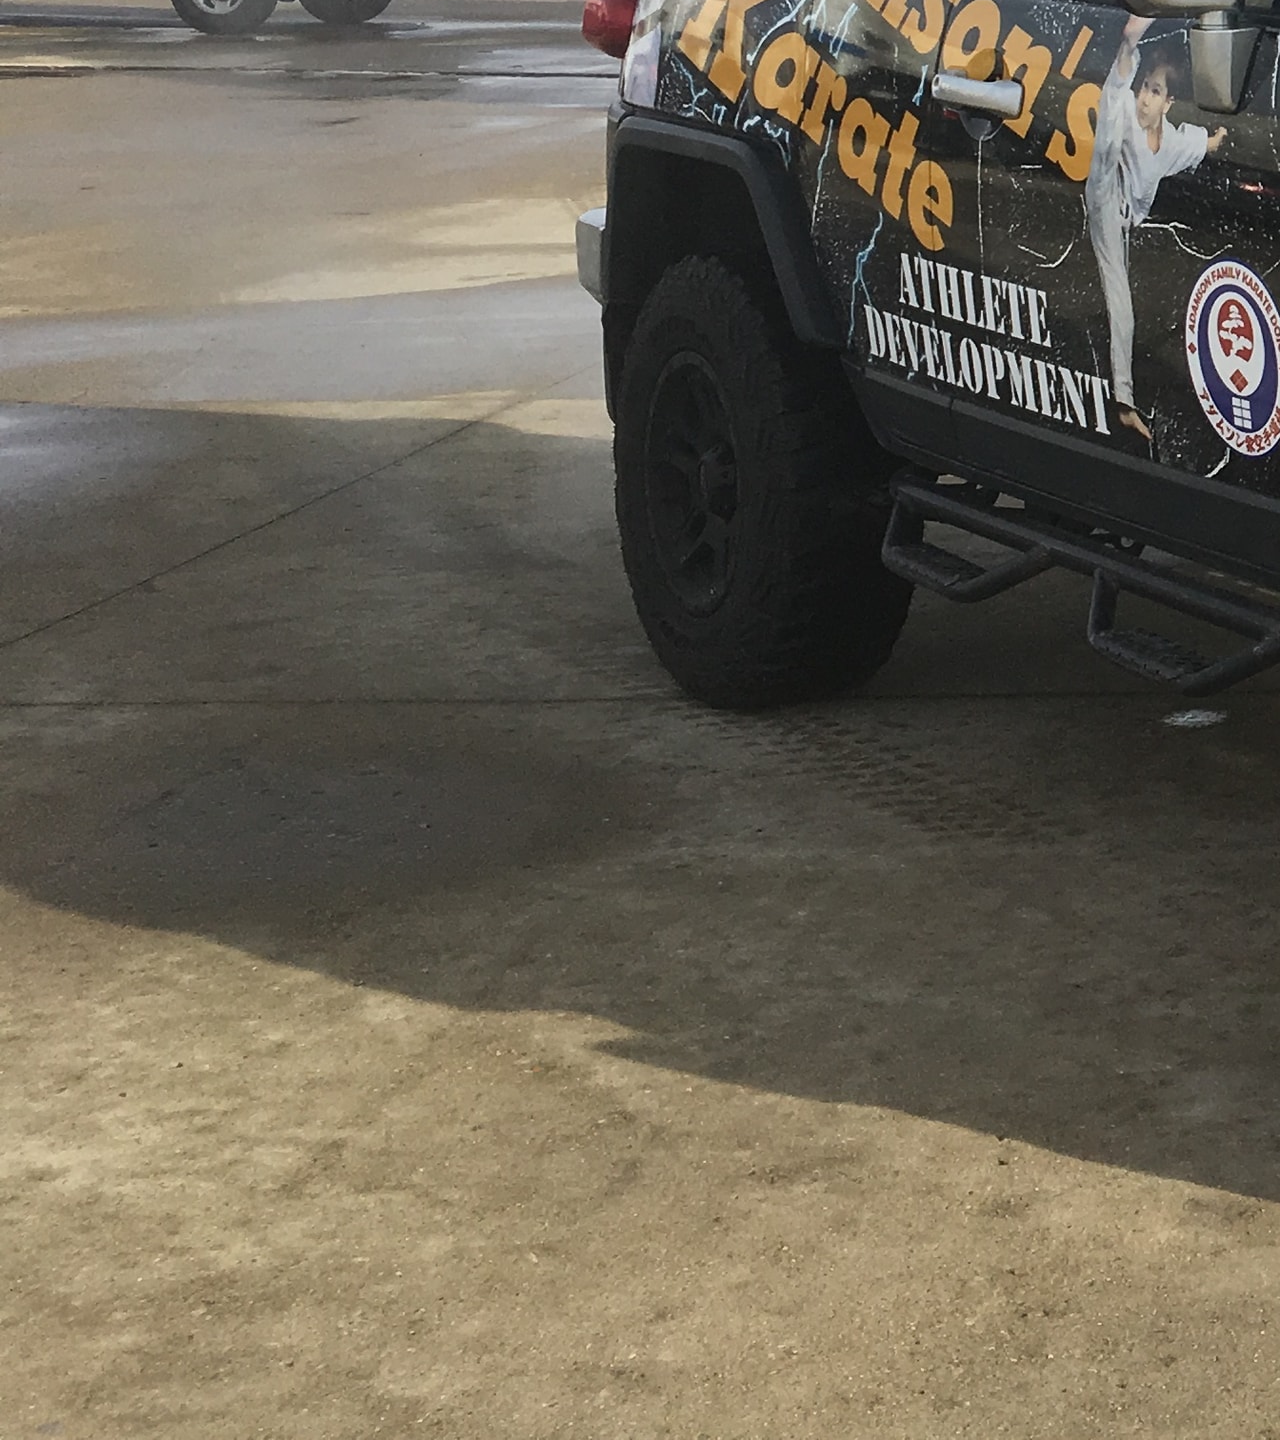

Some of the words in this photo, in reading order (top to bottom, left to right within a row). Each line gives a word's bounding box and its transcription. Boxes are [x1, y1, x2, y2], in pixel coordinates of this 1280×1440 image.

[899, 252, 1052, 348] ATHLETE
[1211, 266, 1241, 282] FAMILY
[1242, 272, 1273, 315] KARATE
[864, 304, 1111, 435] DEVELOPMENT
